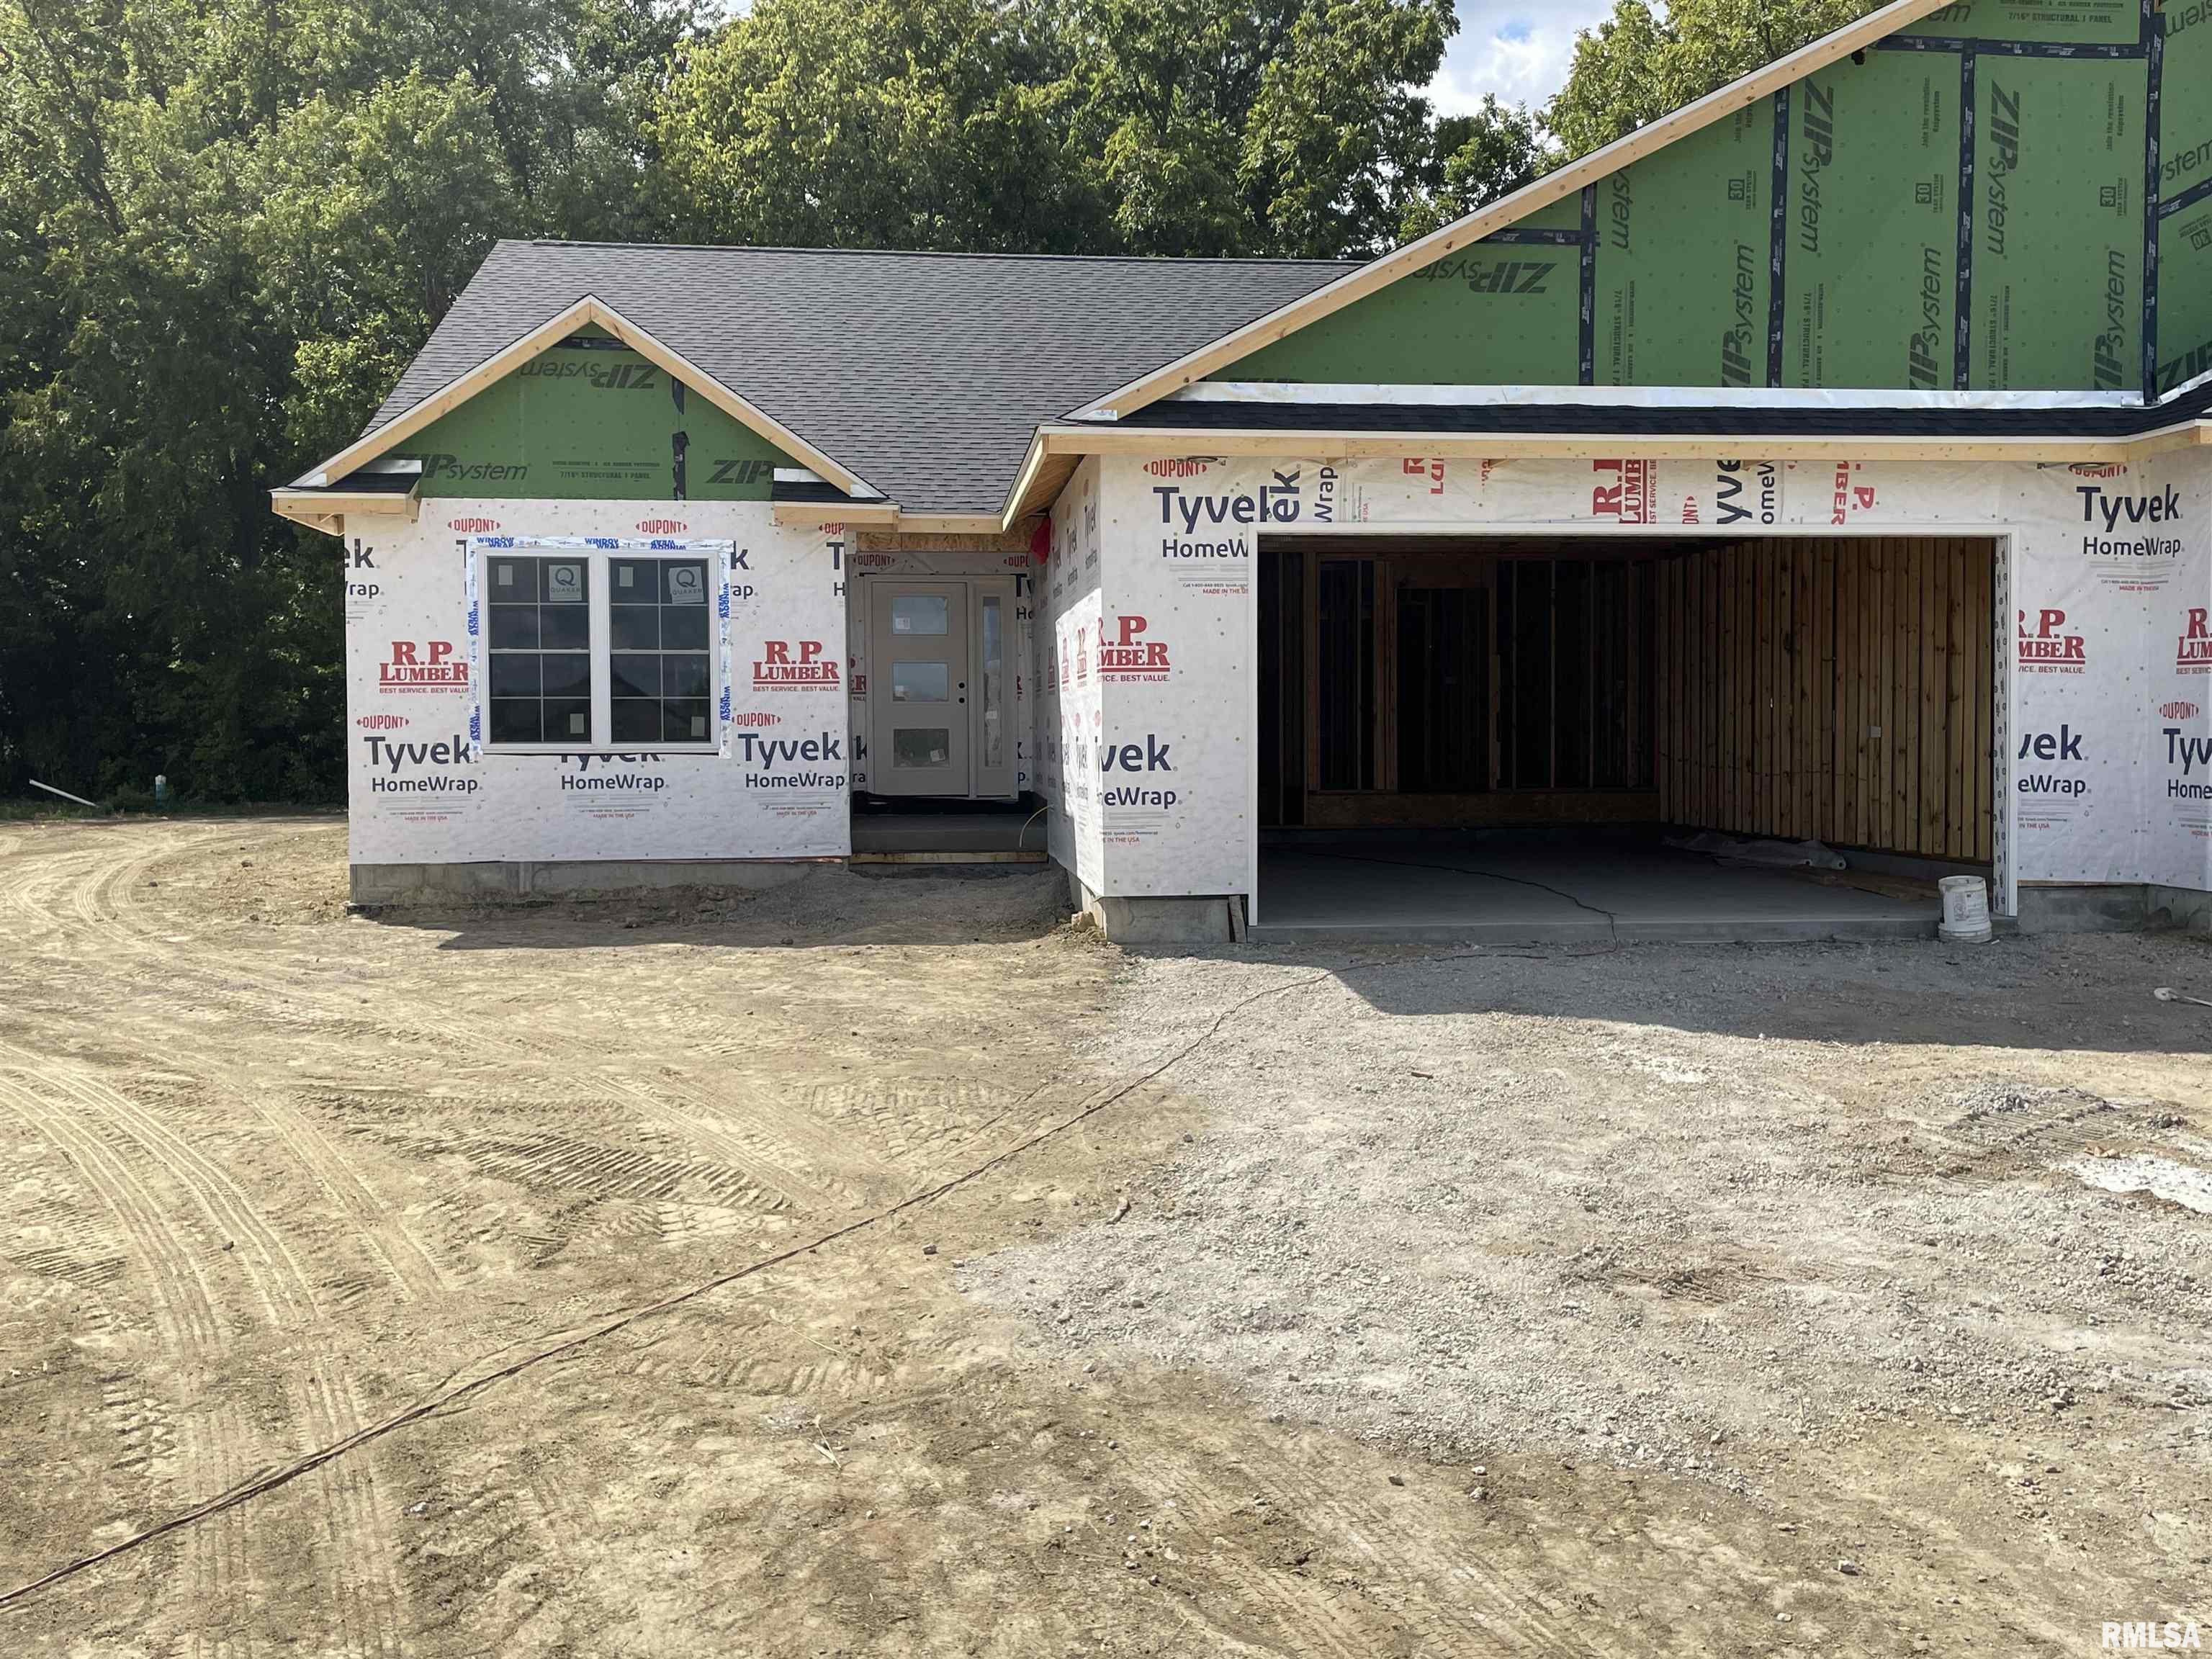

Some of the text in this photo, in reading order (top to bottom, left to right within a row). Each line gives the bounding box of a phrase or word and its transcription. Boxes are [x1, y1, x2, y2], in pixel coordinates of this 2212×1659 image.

[2101, 188, 2115, 206] 30
[2076, 483, 2180, 533] Tyvek
[454, 518, 495, 534] DUPONT
[642, 520, 682, 534] DUPONT
[2083, 536, 2181, 558] HomeWrap
[858, 554, 891, 566] DUPONT
[379, 662, 469, 682] LUMBER
[753, 662, 840, 680] LUMBER
[2163, 702, 2196, 719] DUPONT
[362, 715, 405, 729] DUPONT
[737, 714, 775, 727] DUPONT
[364, 734, 469, 773] Tyvek
[737, 732, 842, 770] Tyvek
[372, 776, 478, 793] HomeWrap
[561, 773, 665, 792] HomeWrap
[745, 771, 845, 789] HomeWrap
